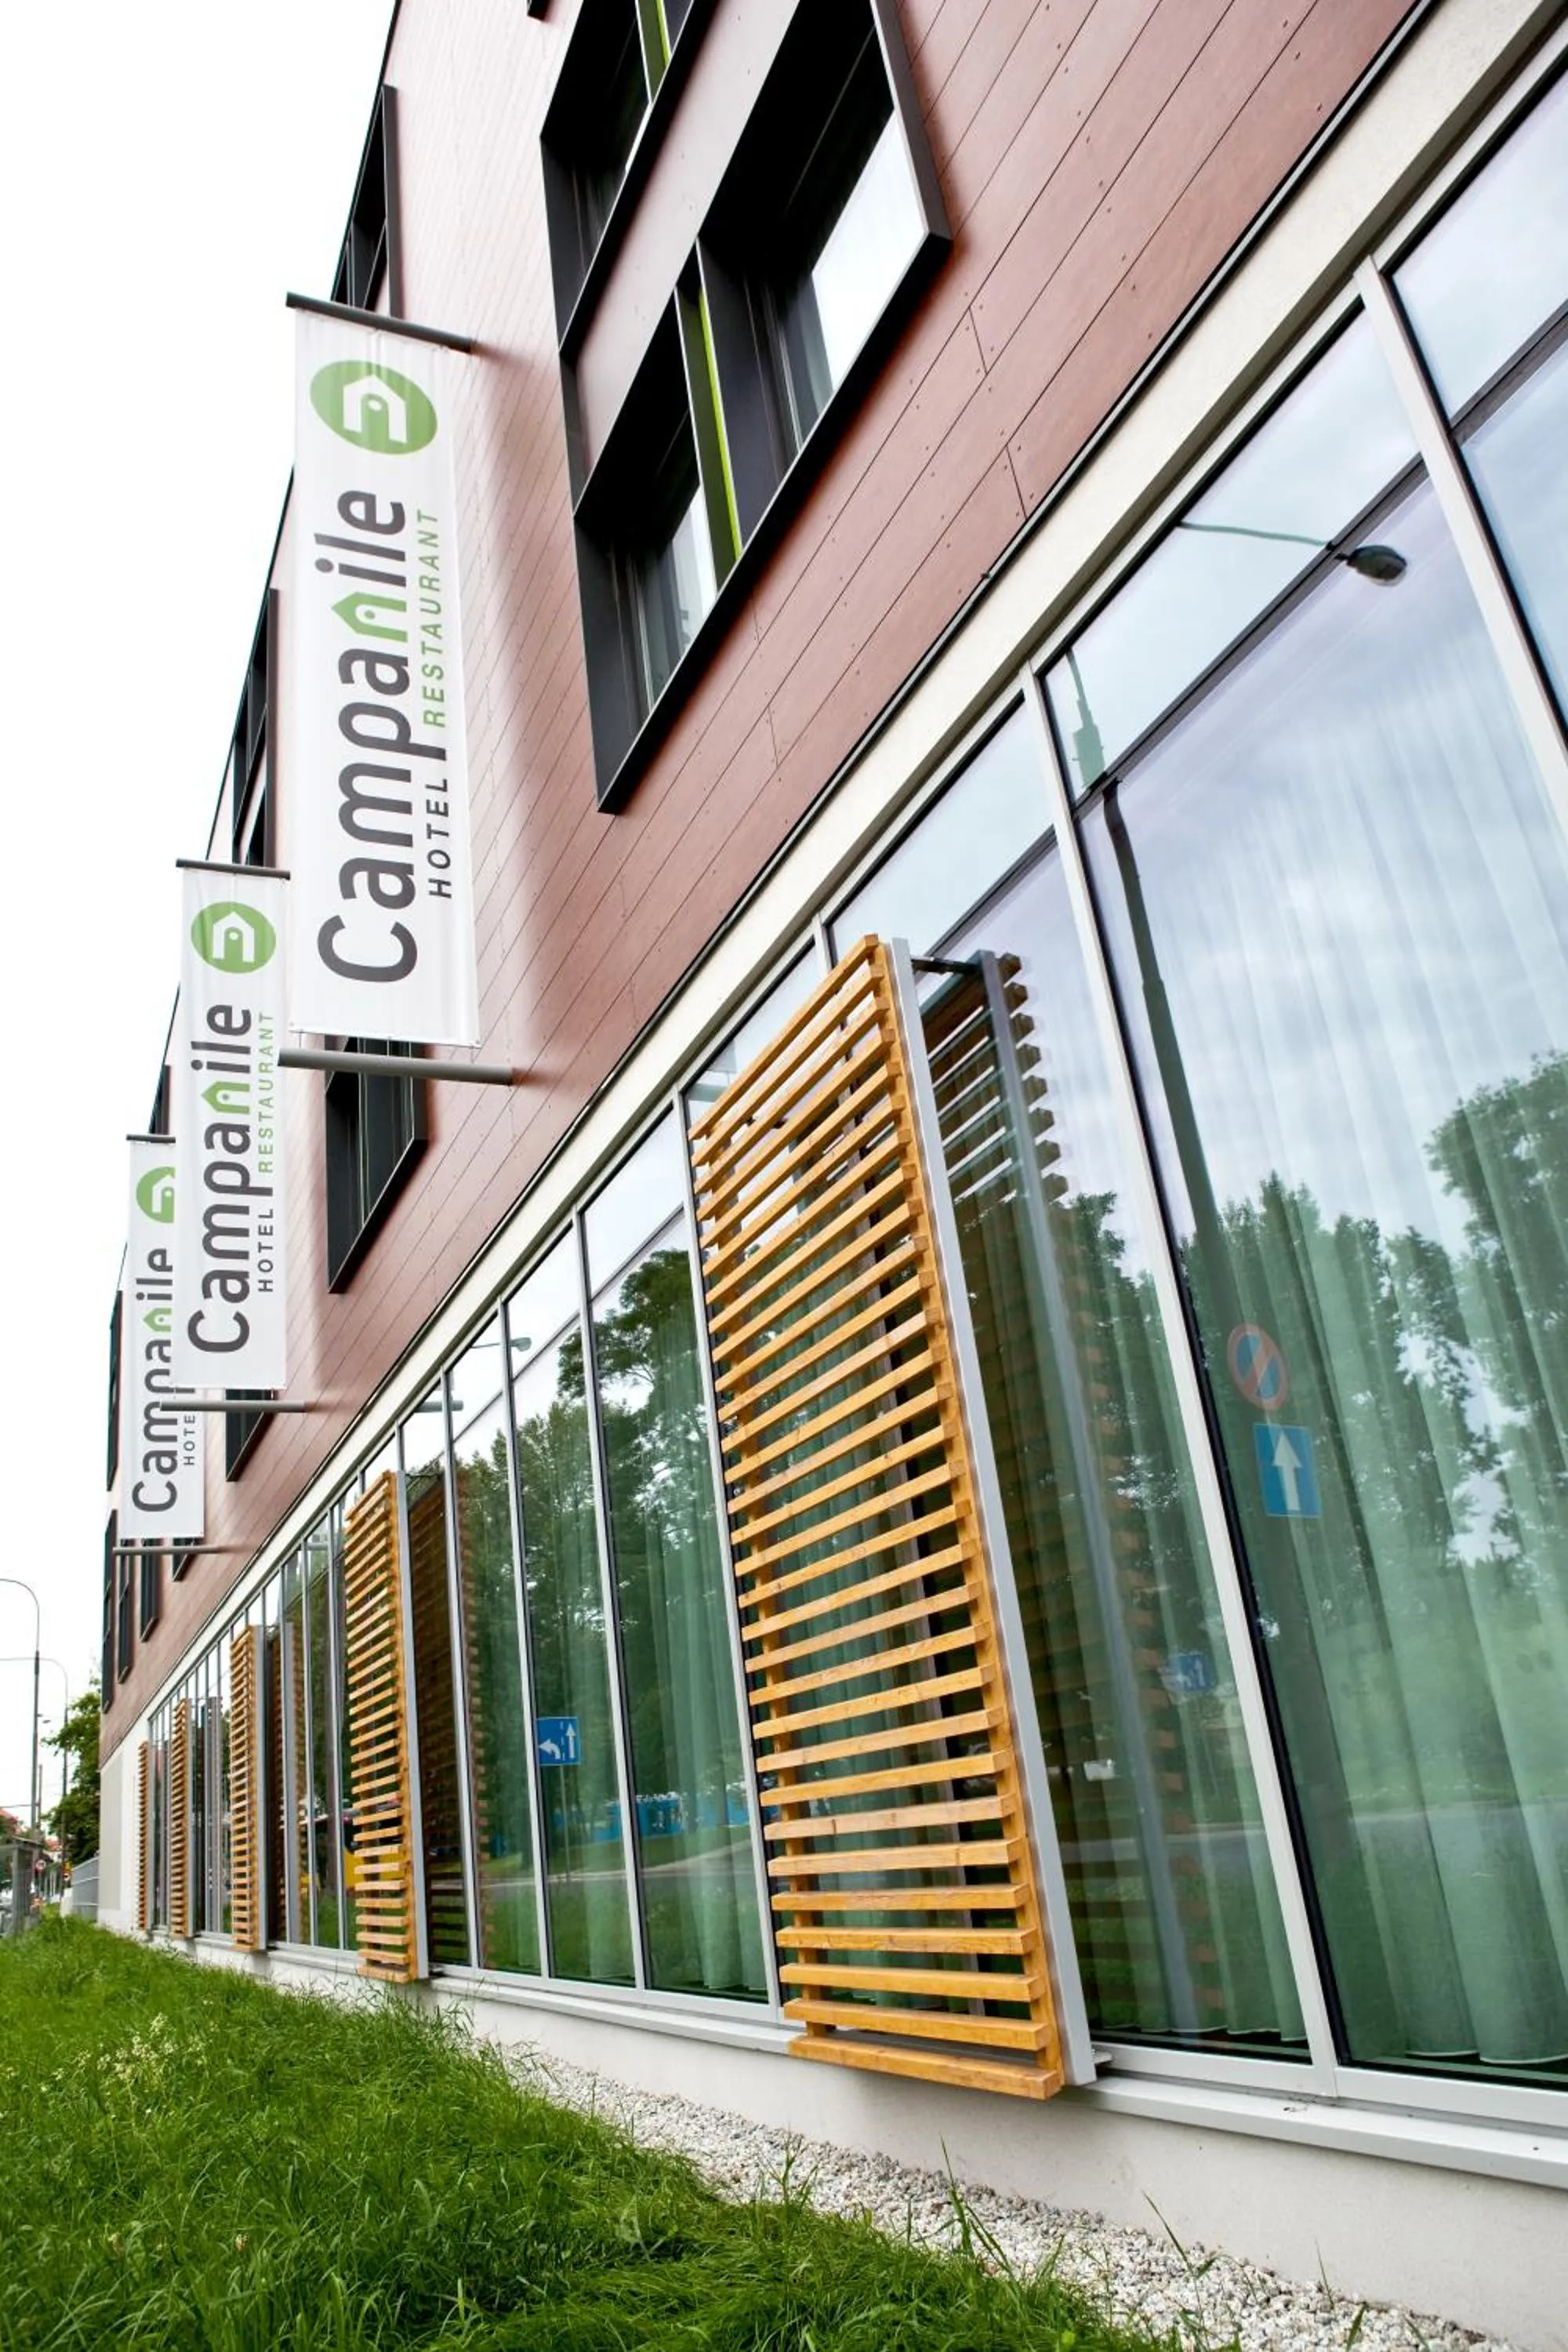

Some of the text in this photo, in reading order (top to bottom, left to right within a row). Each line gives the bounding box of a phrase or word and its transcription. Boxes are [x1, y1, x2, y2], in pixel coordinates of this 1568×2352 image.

[314, 490, 448, 983] Campanile
[416, 509, 452, 900] HOTEL RESTAURANT
[187, 1004, 274, 1353] Campanile
[257, 1012, 274, 1293] HOTEL RESTAURANT
[183, 1414, 196, 1466] HOTE
